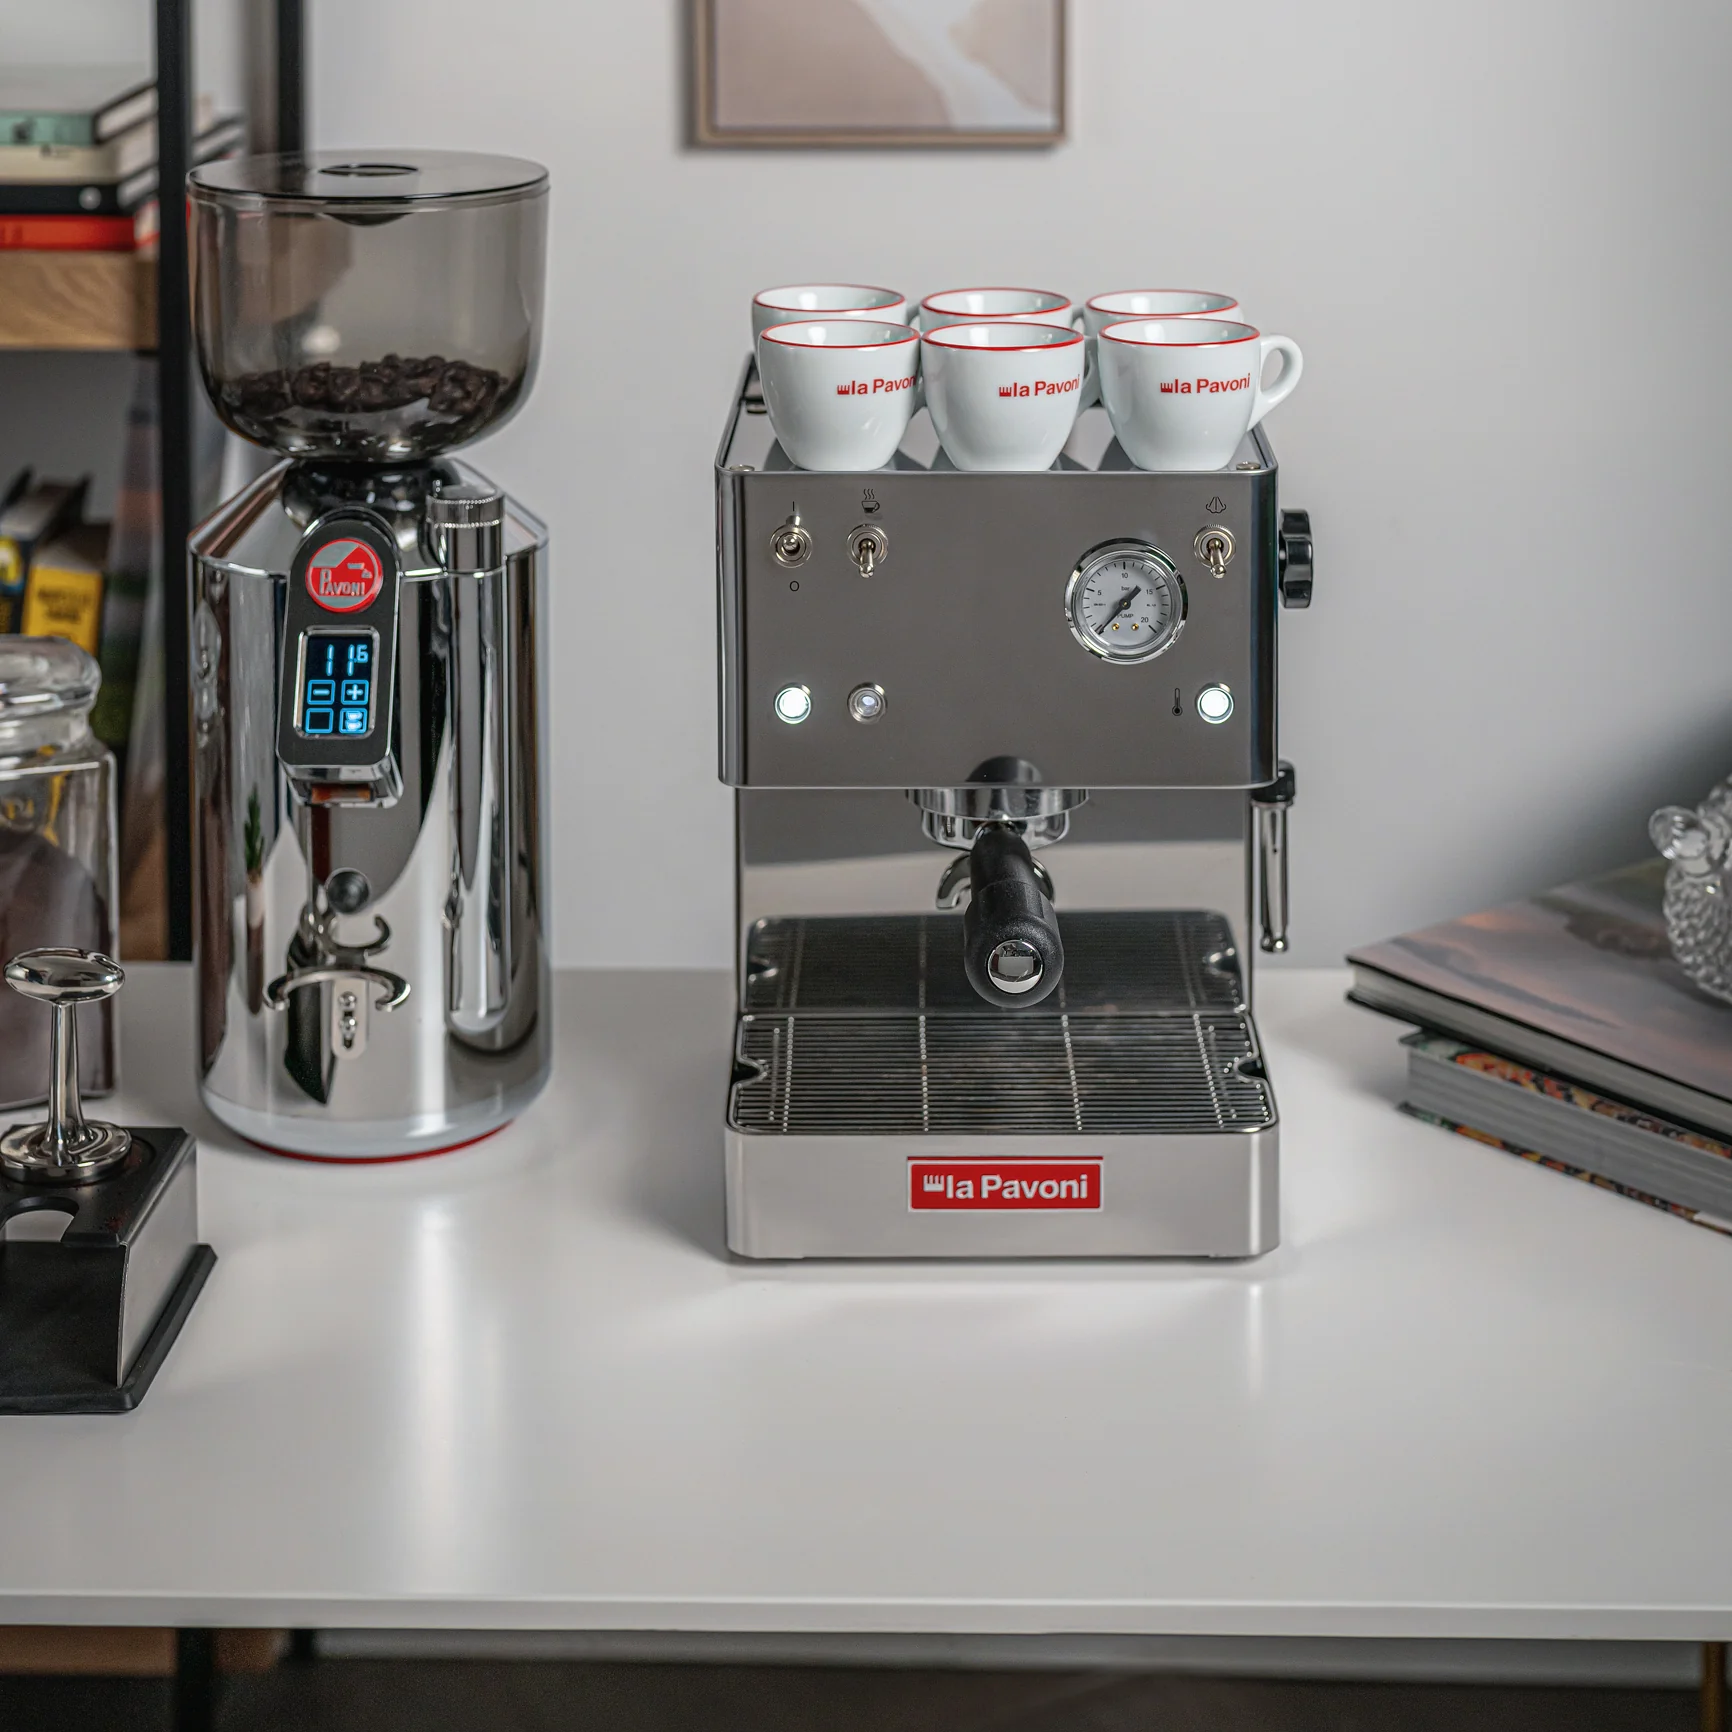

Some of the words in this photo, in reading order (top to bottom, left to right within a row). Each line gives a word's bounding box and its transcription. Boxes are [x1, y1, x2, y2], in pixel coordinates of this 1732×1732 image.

[851, 380, 868, 395] la
[873, 375, 916, 394] Pavon
[1013, 382, 1030, 397] la
[1034, 374, 1080, 396] Pavoni
[1174, 378, 1192, 394] la
[1196, 372, 1251, 394] Pavoni
[945, 1174, 974, 1200] la
[980, 1173, 1088, 1200] Pavoni
